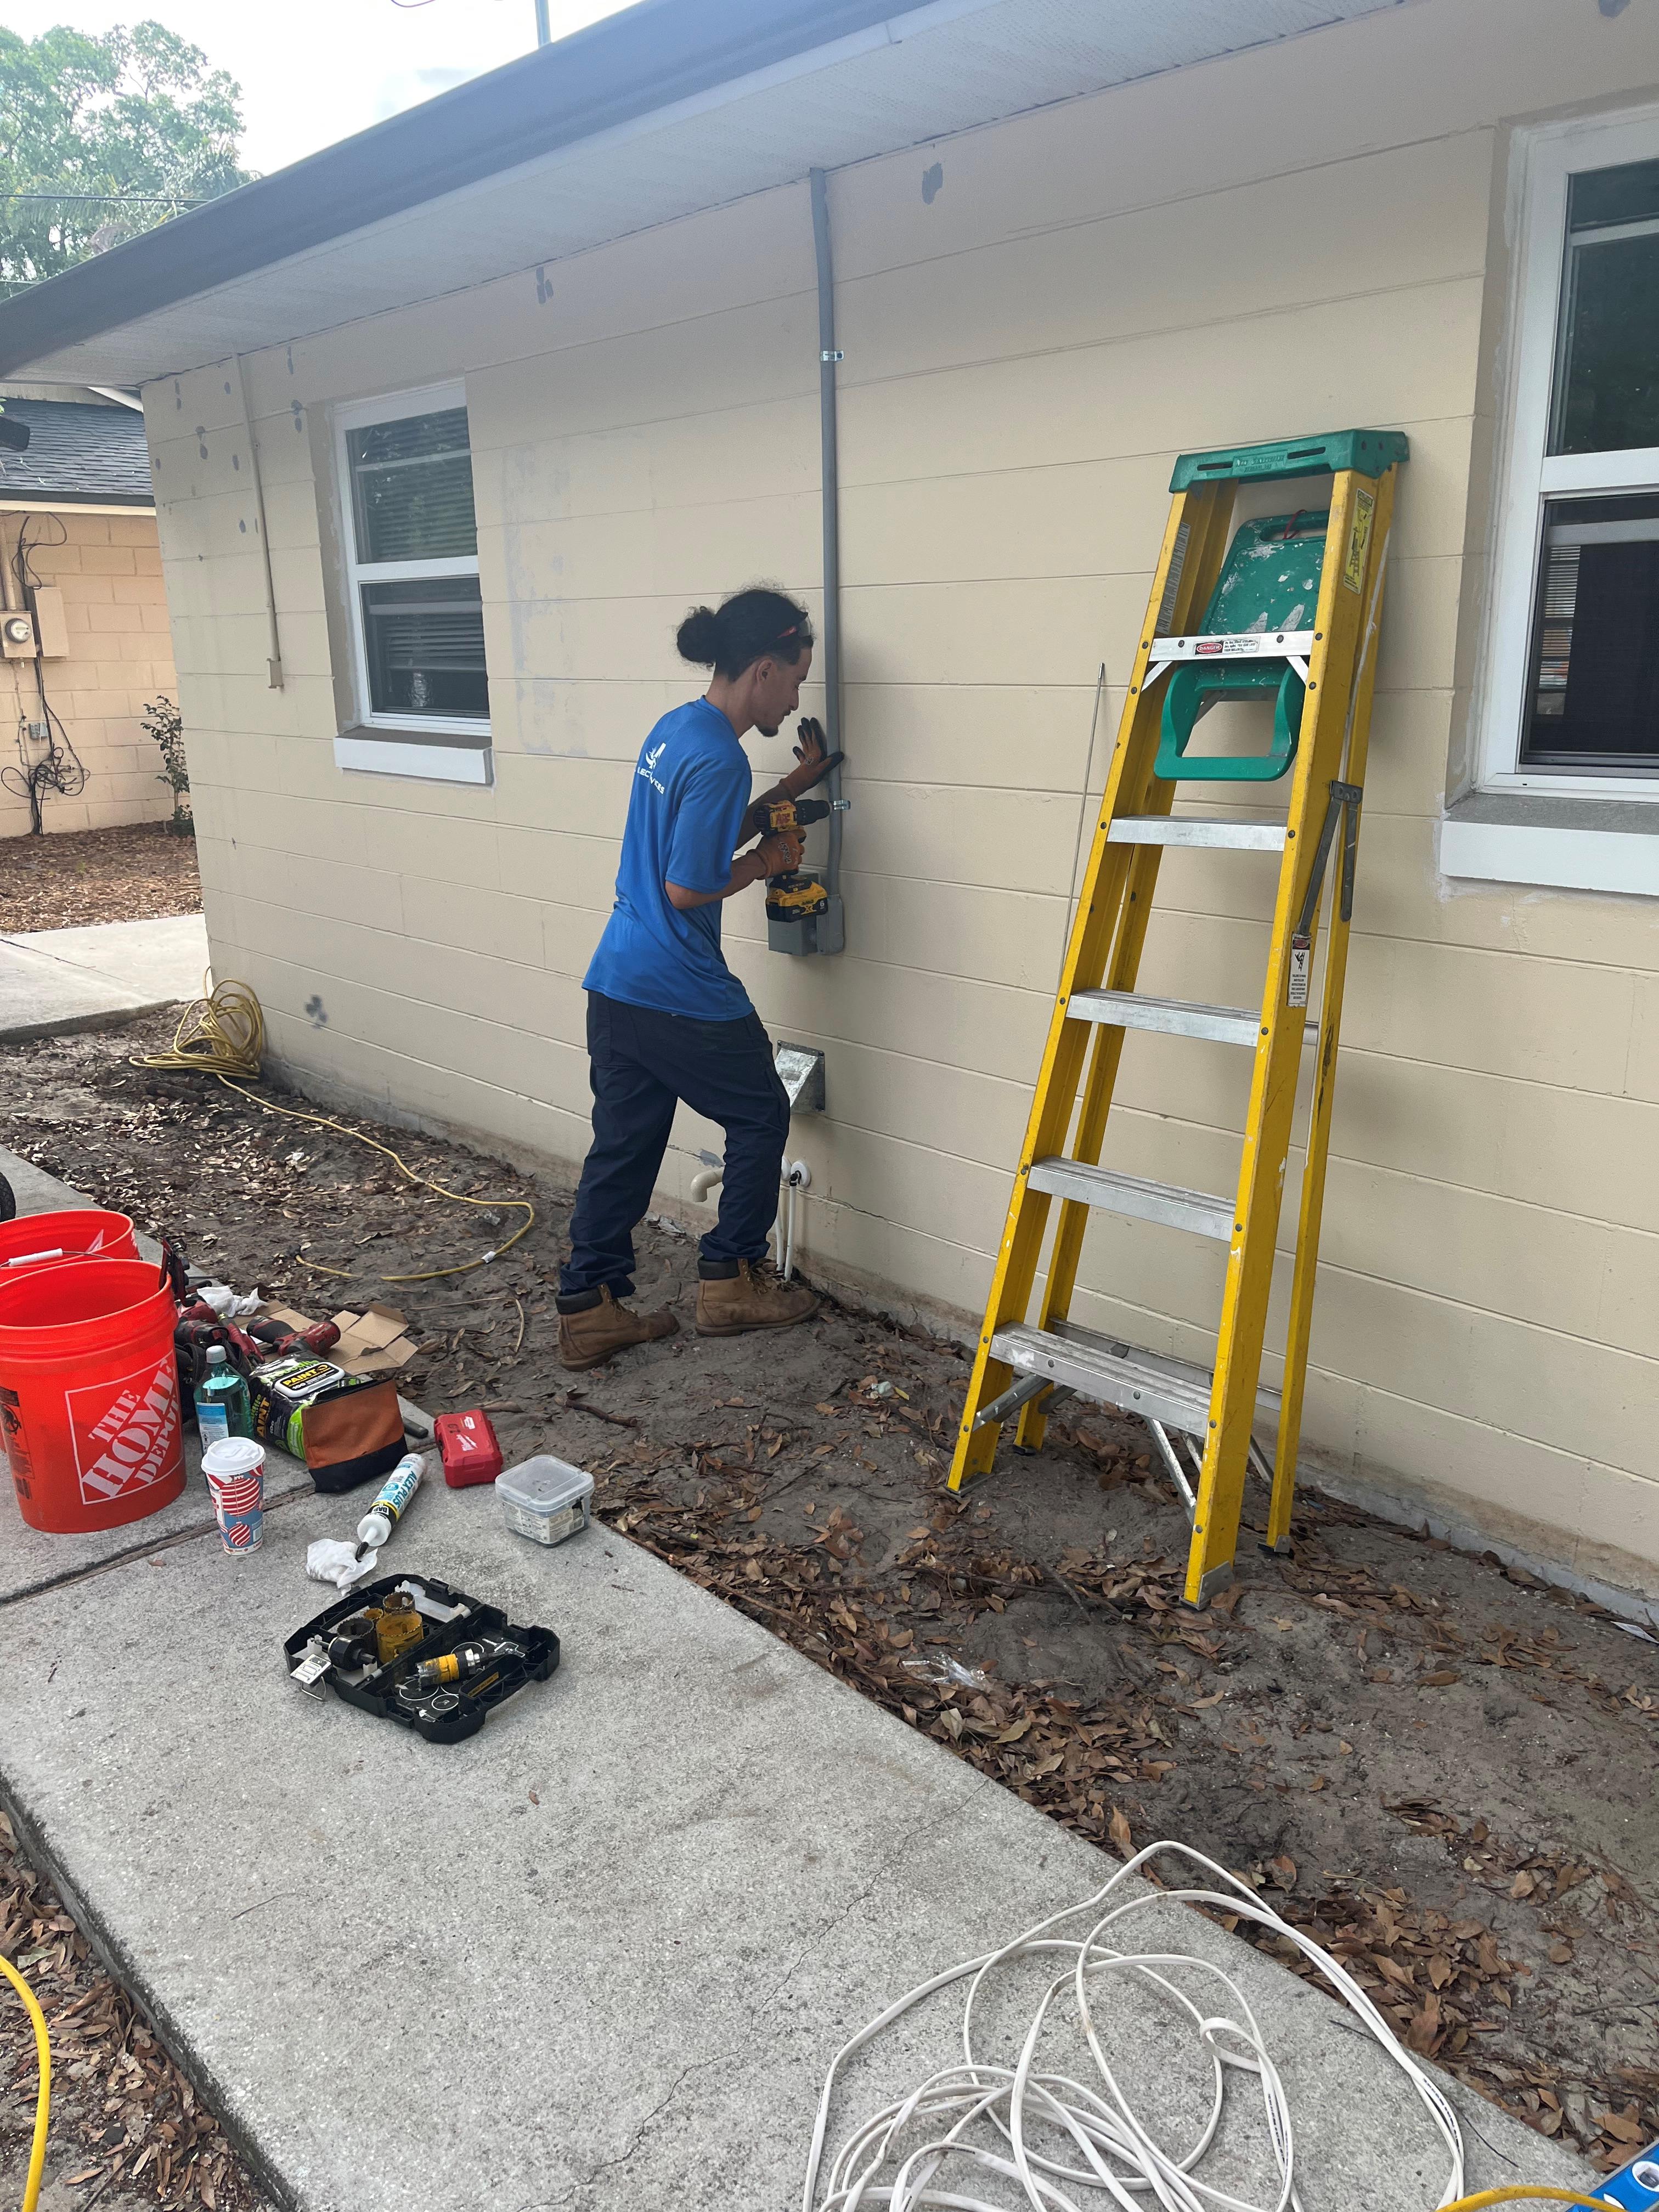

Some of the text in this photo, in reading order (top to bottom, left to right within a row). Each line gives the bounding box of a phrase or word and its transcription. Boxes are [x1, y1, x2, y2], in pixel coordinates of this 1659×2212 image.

[283, 1369, 317, 1386] PAINT
[82, 1358, 176, 1497] HOME
[87, 1389, 141, 1443] THE
[256, 1397, 270, 1438] AINT
[402, 1470, 417, 1492] ALEX
[392, 1486, 408, 1509] PLUS
